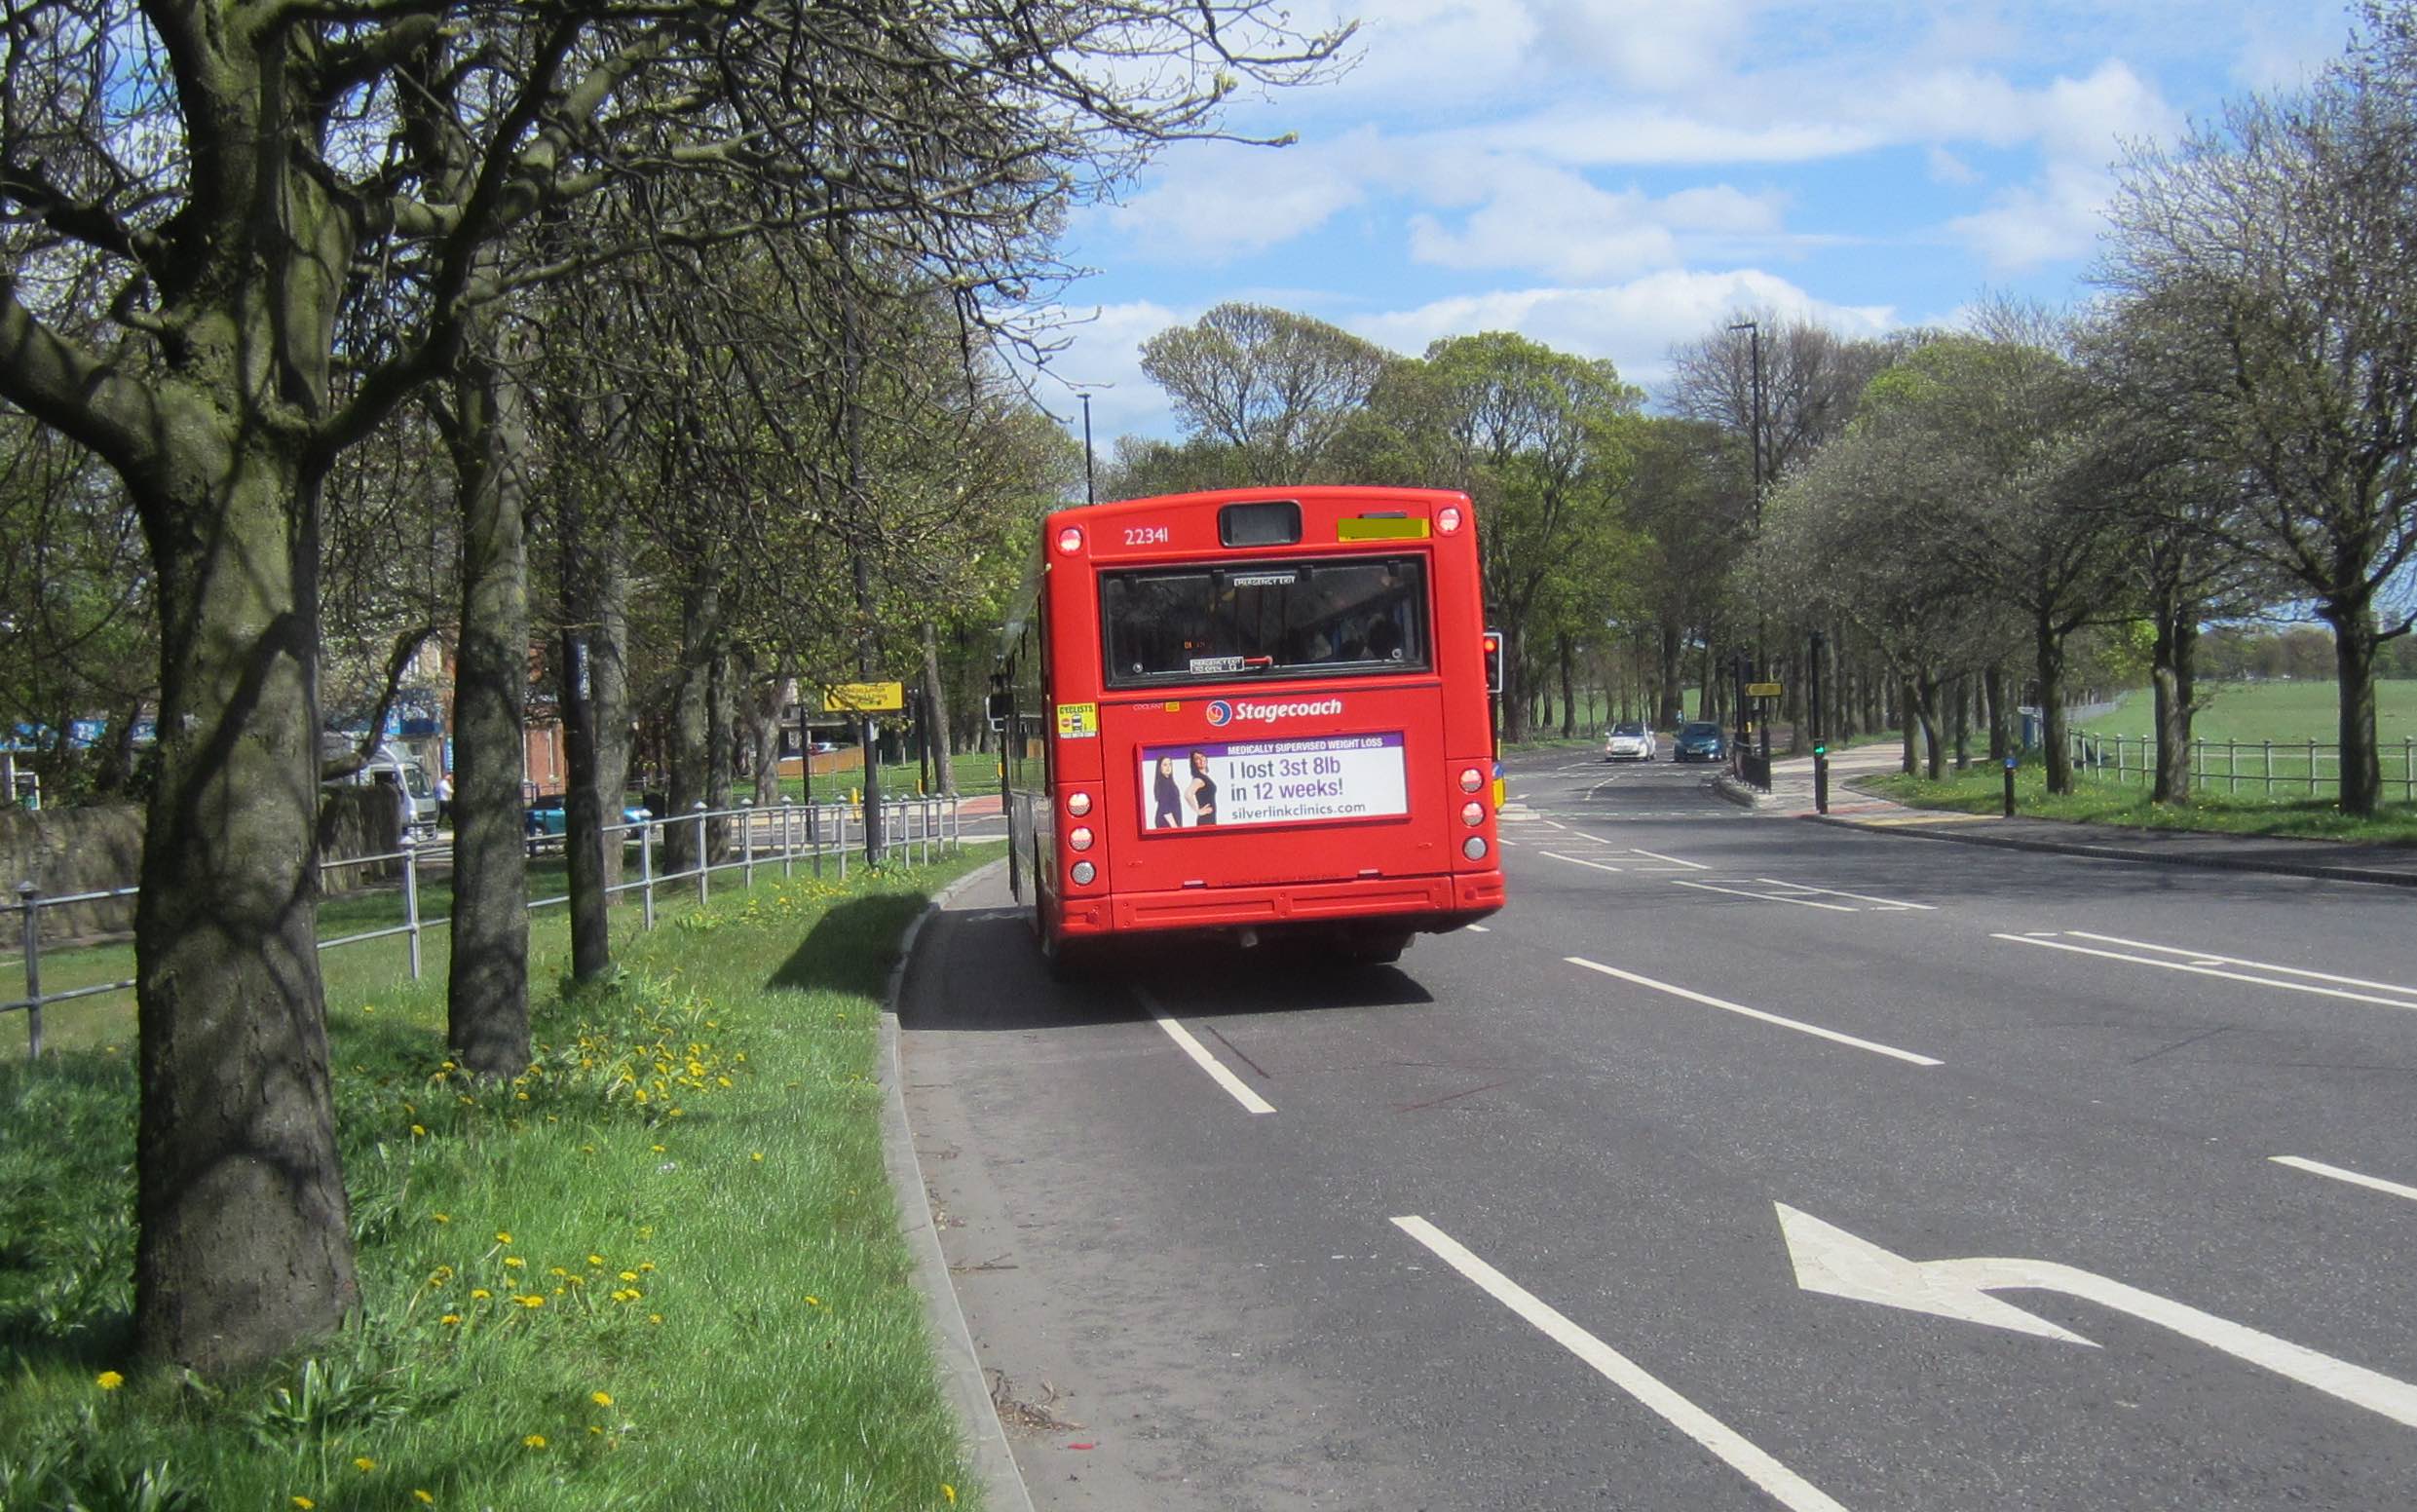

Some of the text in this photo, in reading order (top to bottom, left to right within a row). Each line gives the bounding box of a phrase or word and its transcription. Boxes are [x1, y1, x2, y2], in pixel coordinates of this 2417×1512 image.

[1124, 527, 1168, 545] 22341
[1235, 699, 1341, 723] Stagecoach
[1227, 737, 1382, 755] MEDICALLY SUPERVISED WEIGHT LOSS
[1229, 756, 1341, 779] I lost 3st 8lb
[1230, 777, 1342, 802] in 12 weeks!
[1231, 803, 1366, 819] silverlinkclinics.com
